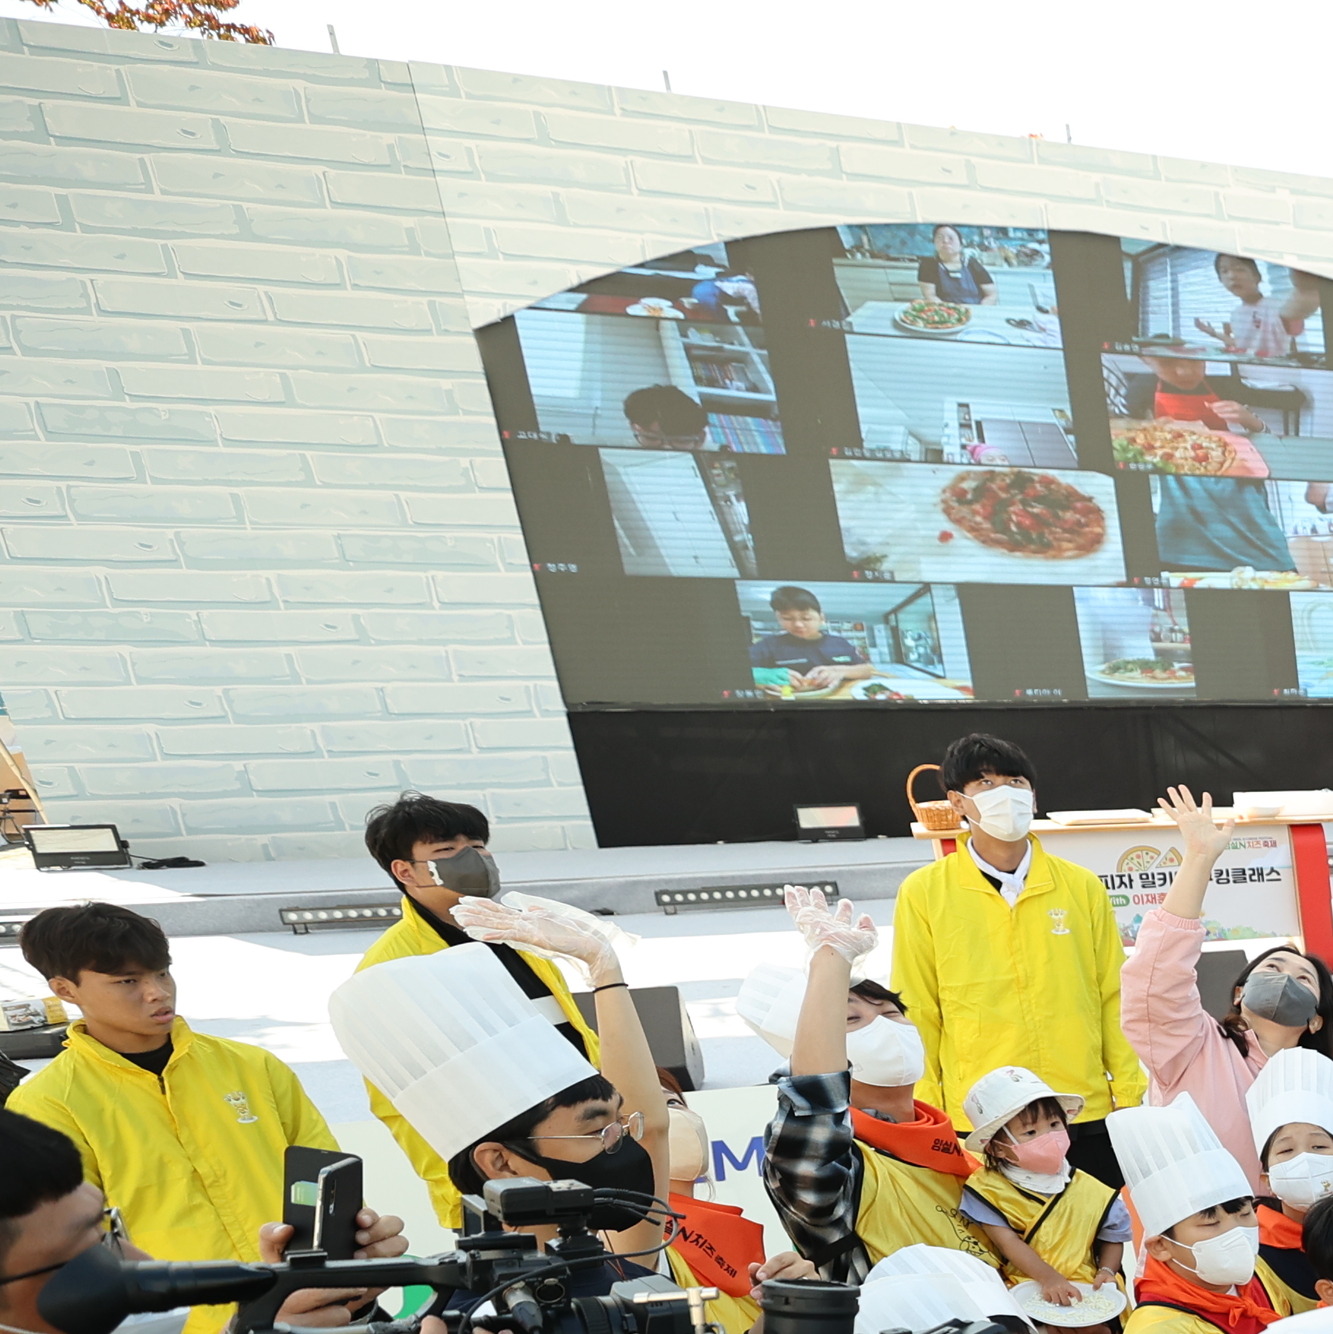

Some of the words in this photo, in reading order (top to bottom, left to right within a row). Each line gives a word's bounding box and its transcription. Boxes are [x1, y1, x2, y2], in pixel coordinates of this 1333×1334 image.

[1100, 873, 1133, 890] 피자
[1139, 871, 1178, 889] 밀키
[1209, 867, 1282, 885] 킹클래스
